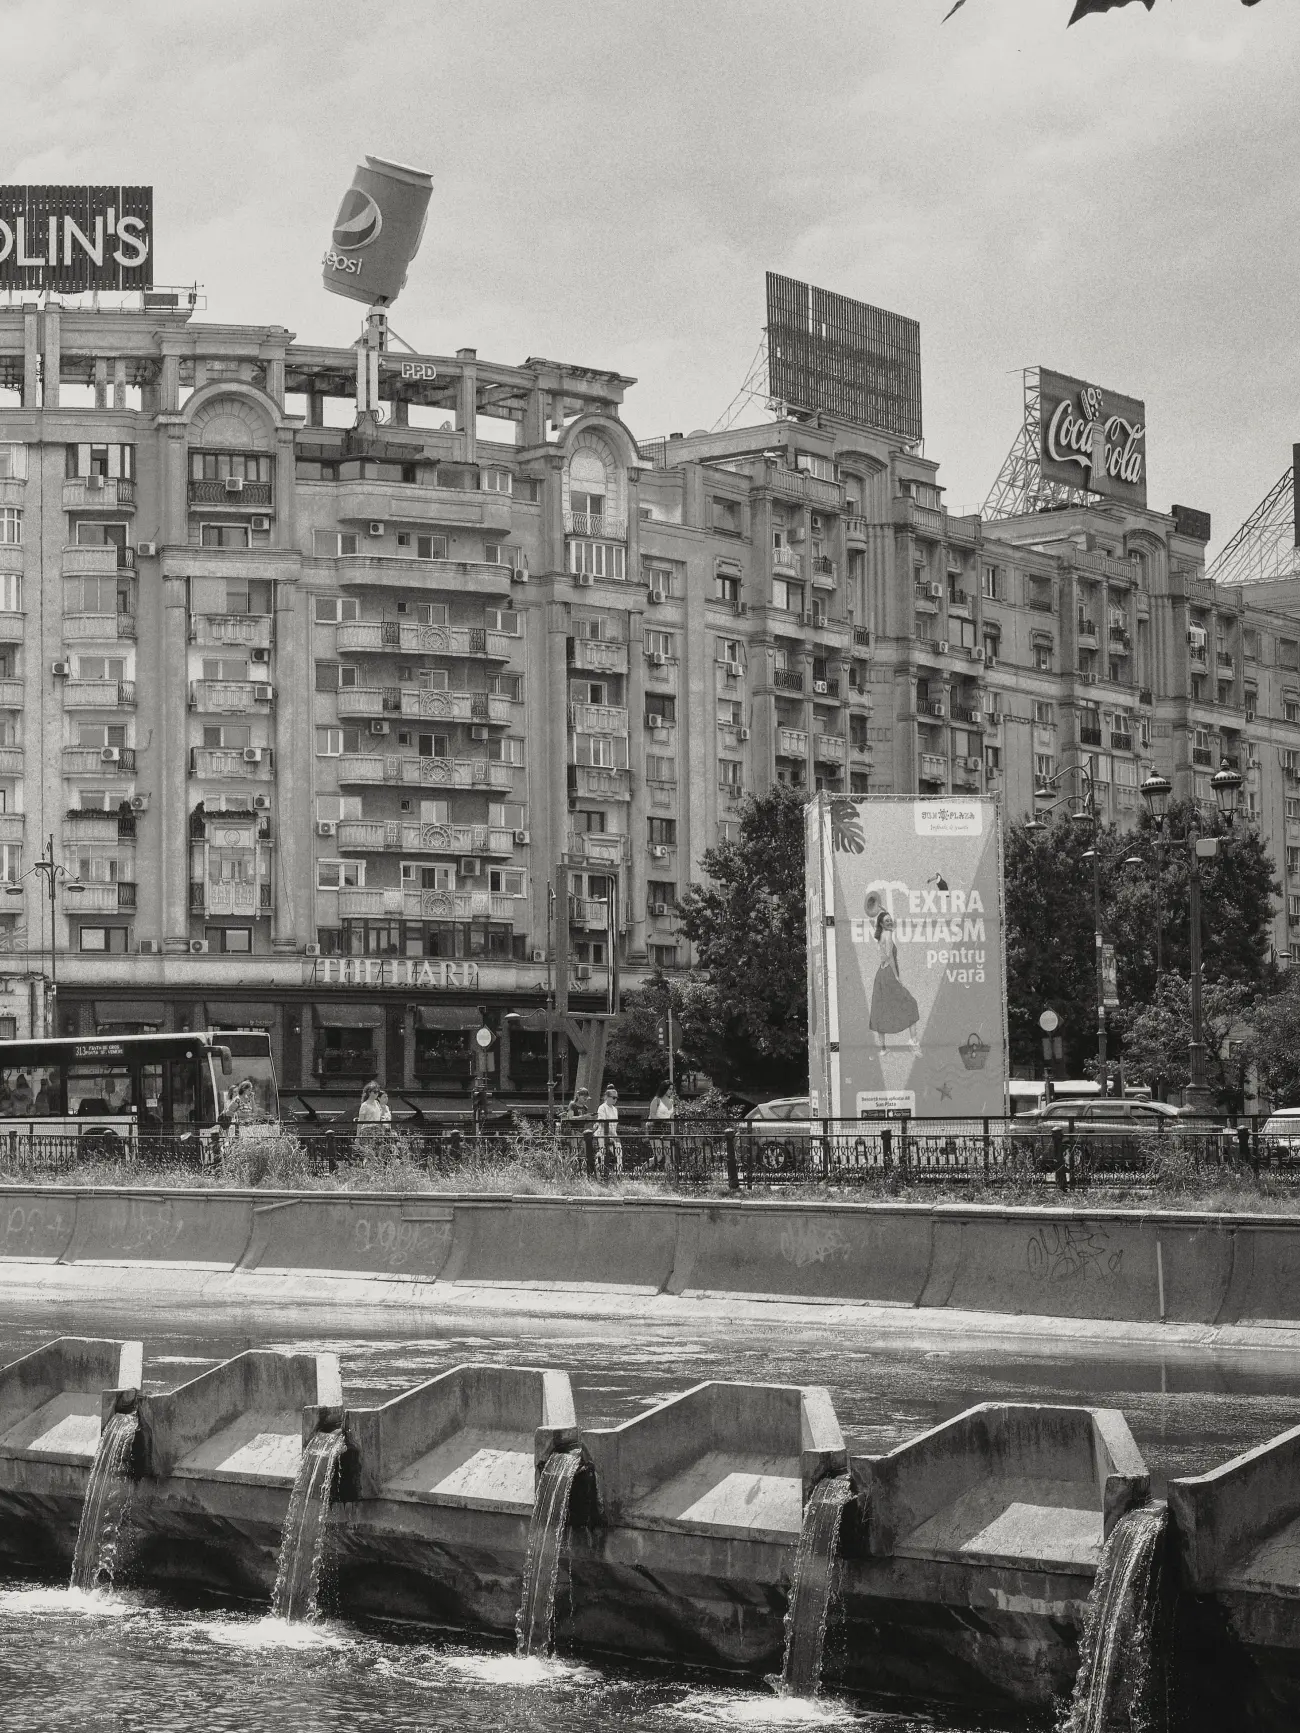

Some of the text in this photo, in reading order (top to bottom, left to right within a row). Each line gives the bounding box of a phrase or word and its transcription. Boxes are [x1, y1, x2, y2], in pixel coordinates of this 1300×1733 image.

[401, 361, 437, 380] PPD
[908, 889, 985, 913] EXTRA
[926, 947, 986, 969] pentru
[316, 958, 382, 983] THE
[946, 964, 986, 983] vară
